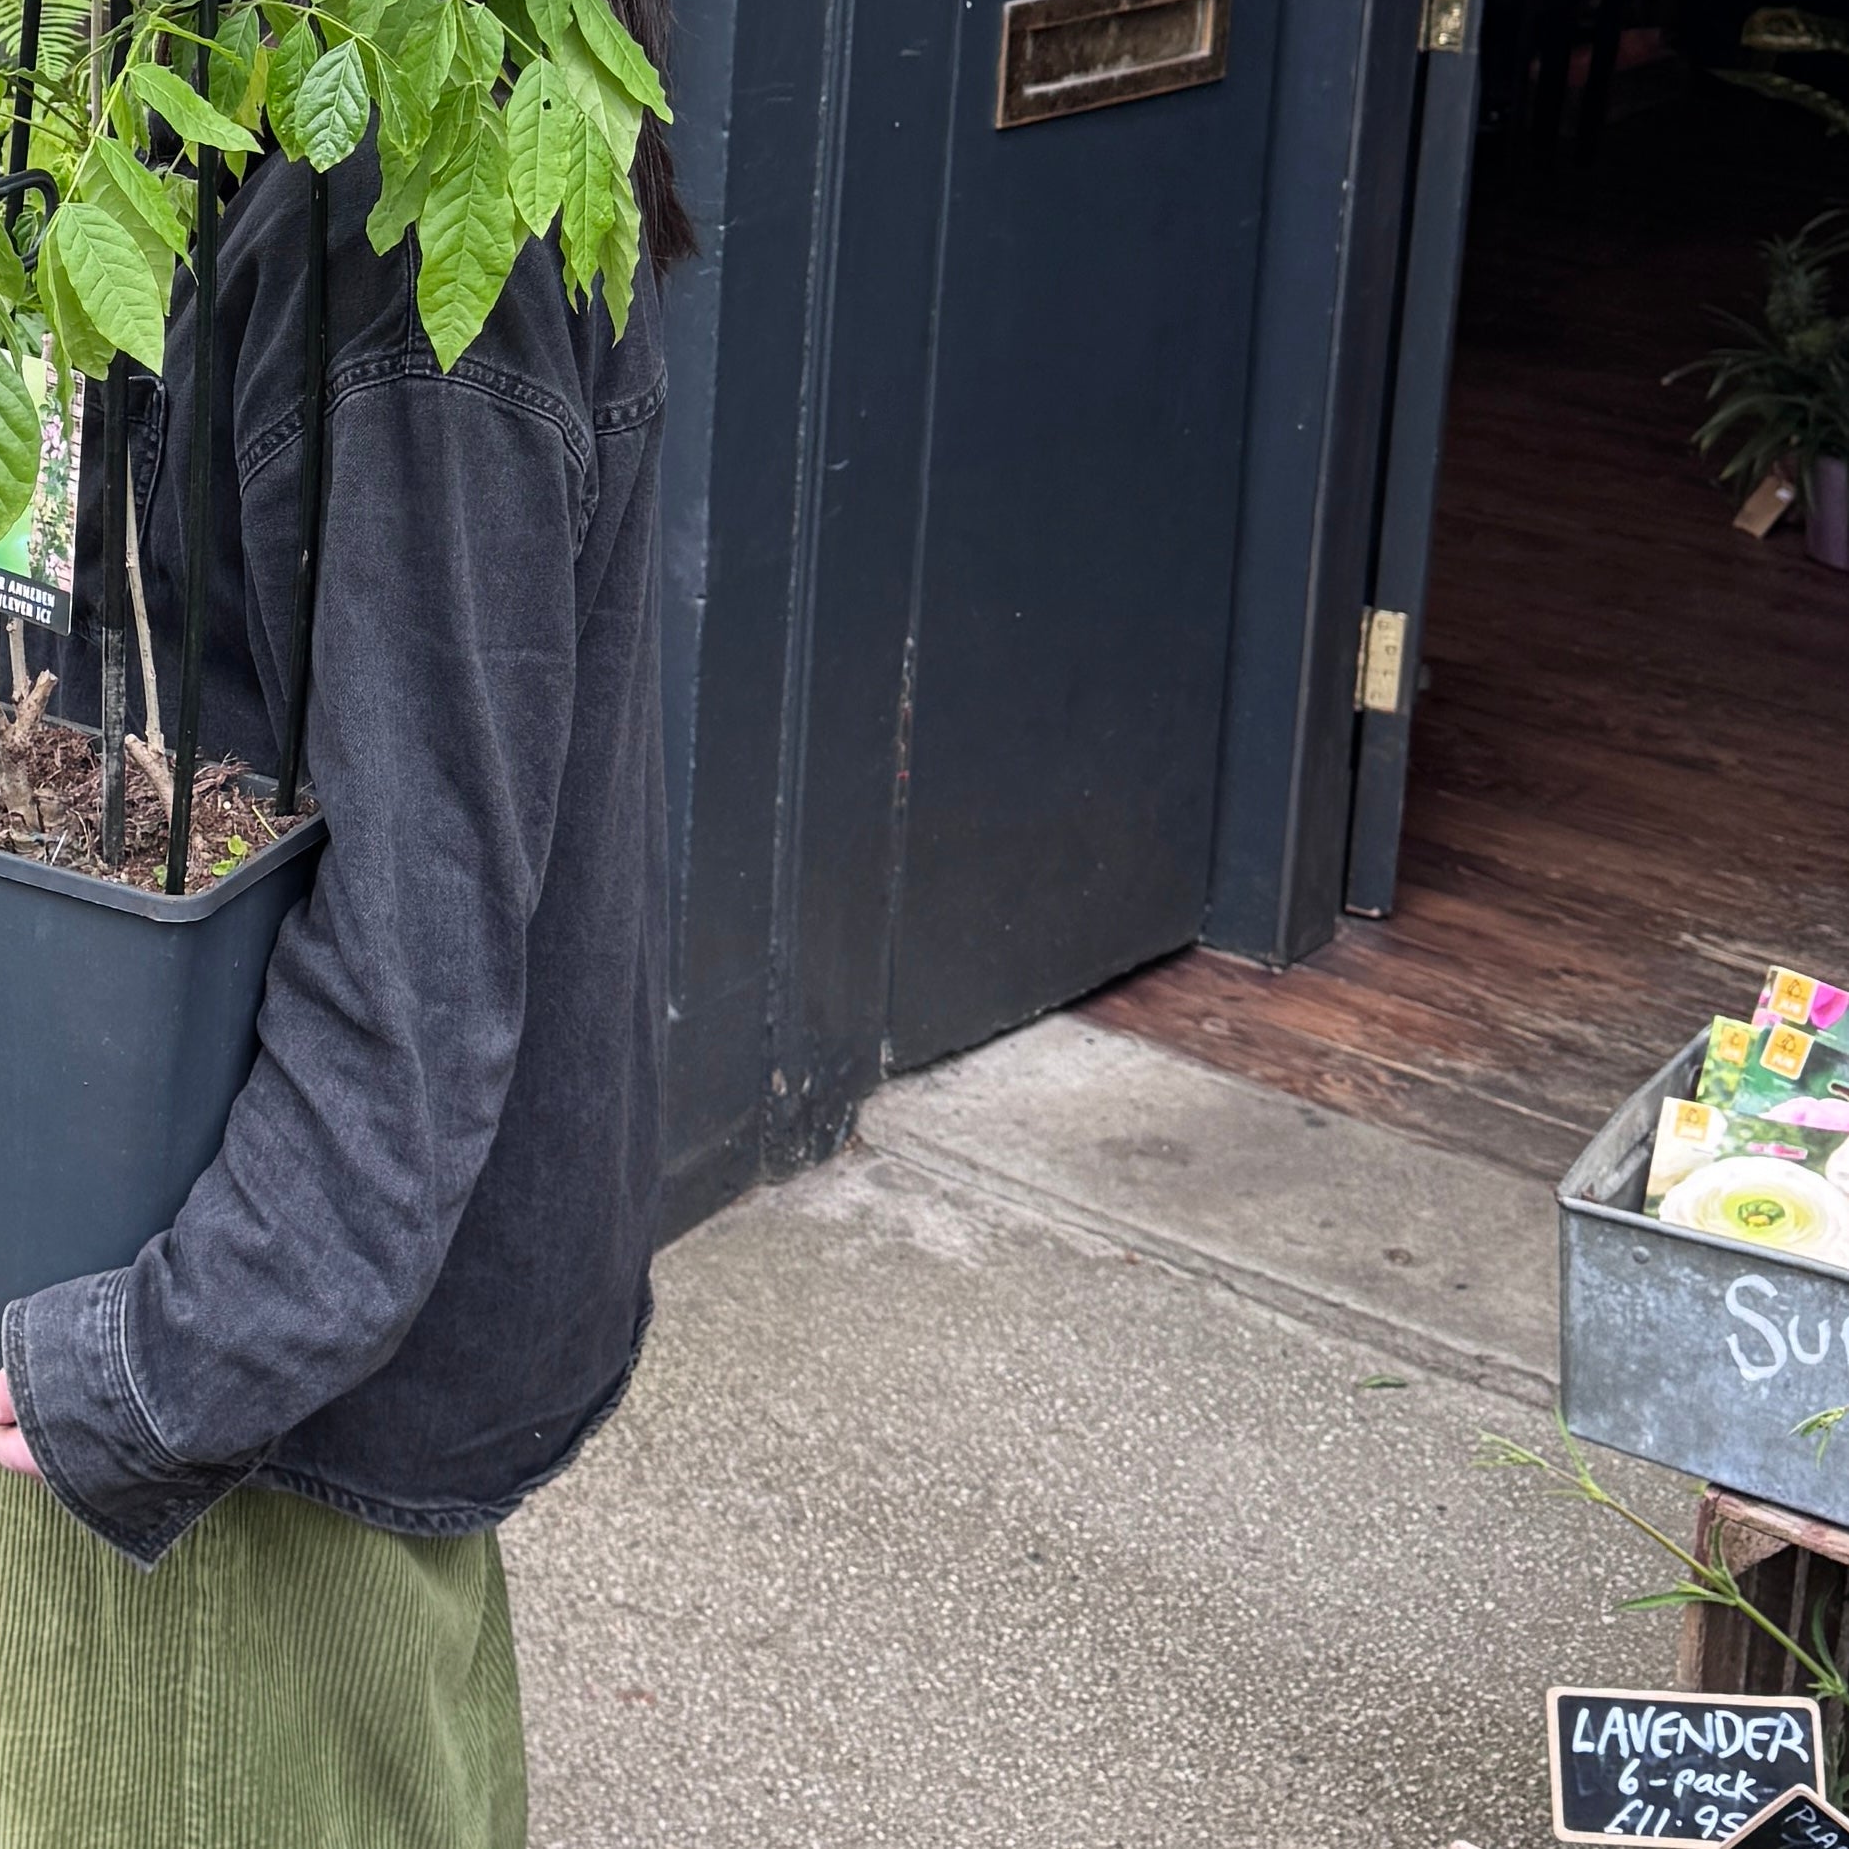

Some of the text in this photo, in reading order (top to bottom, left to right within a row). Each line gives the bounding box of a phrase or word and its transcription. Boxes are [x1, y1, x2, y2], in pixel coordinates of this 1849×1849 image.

[36, 607, 52, 625] ICI
[1725, 1274, 1849, 1381] Su
[1572, 1706, 1809, 1763] LAVENDER
